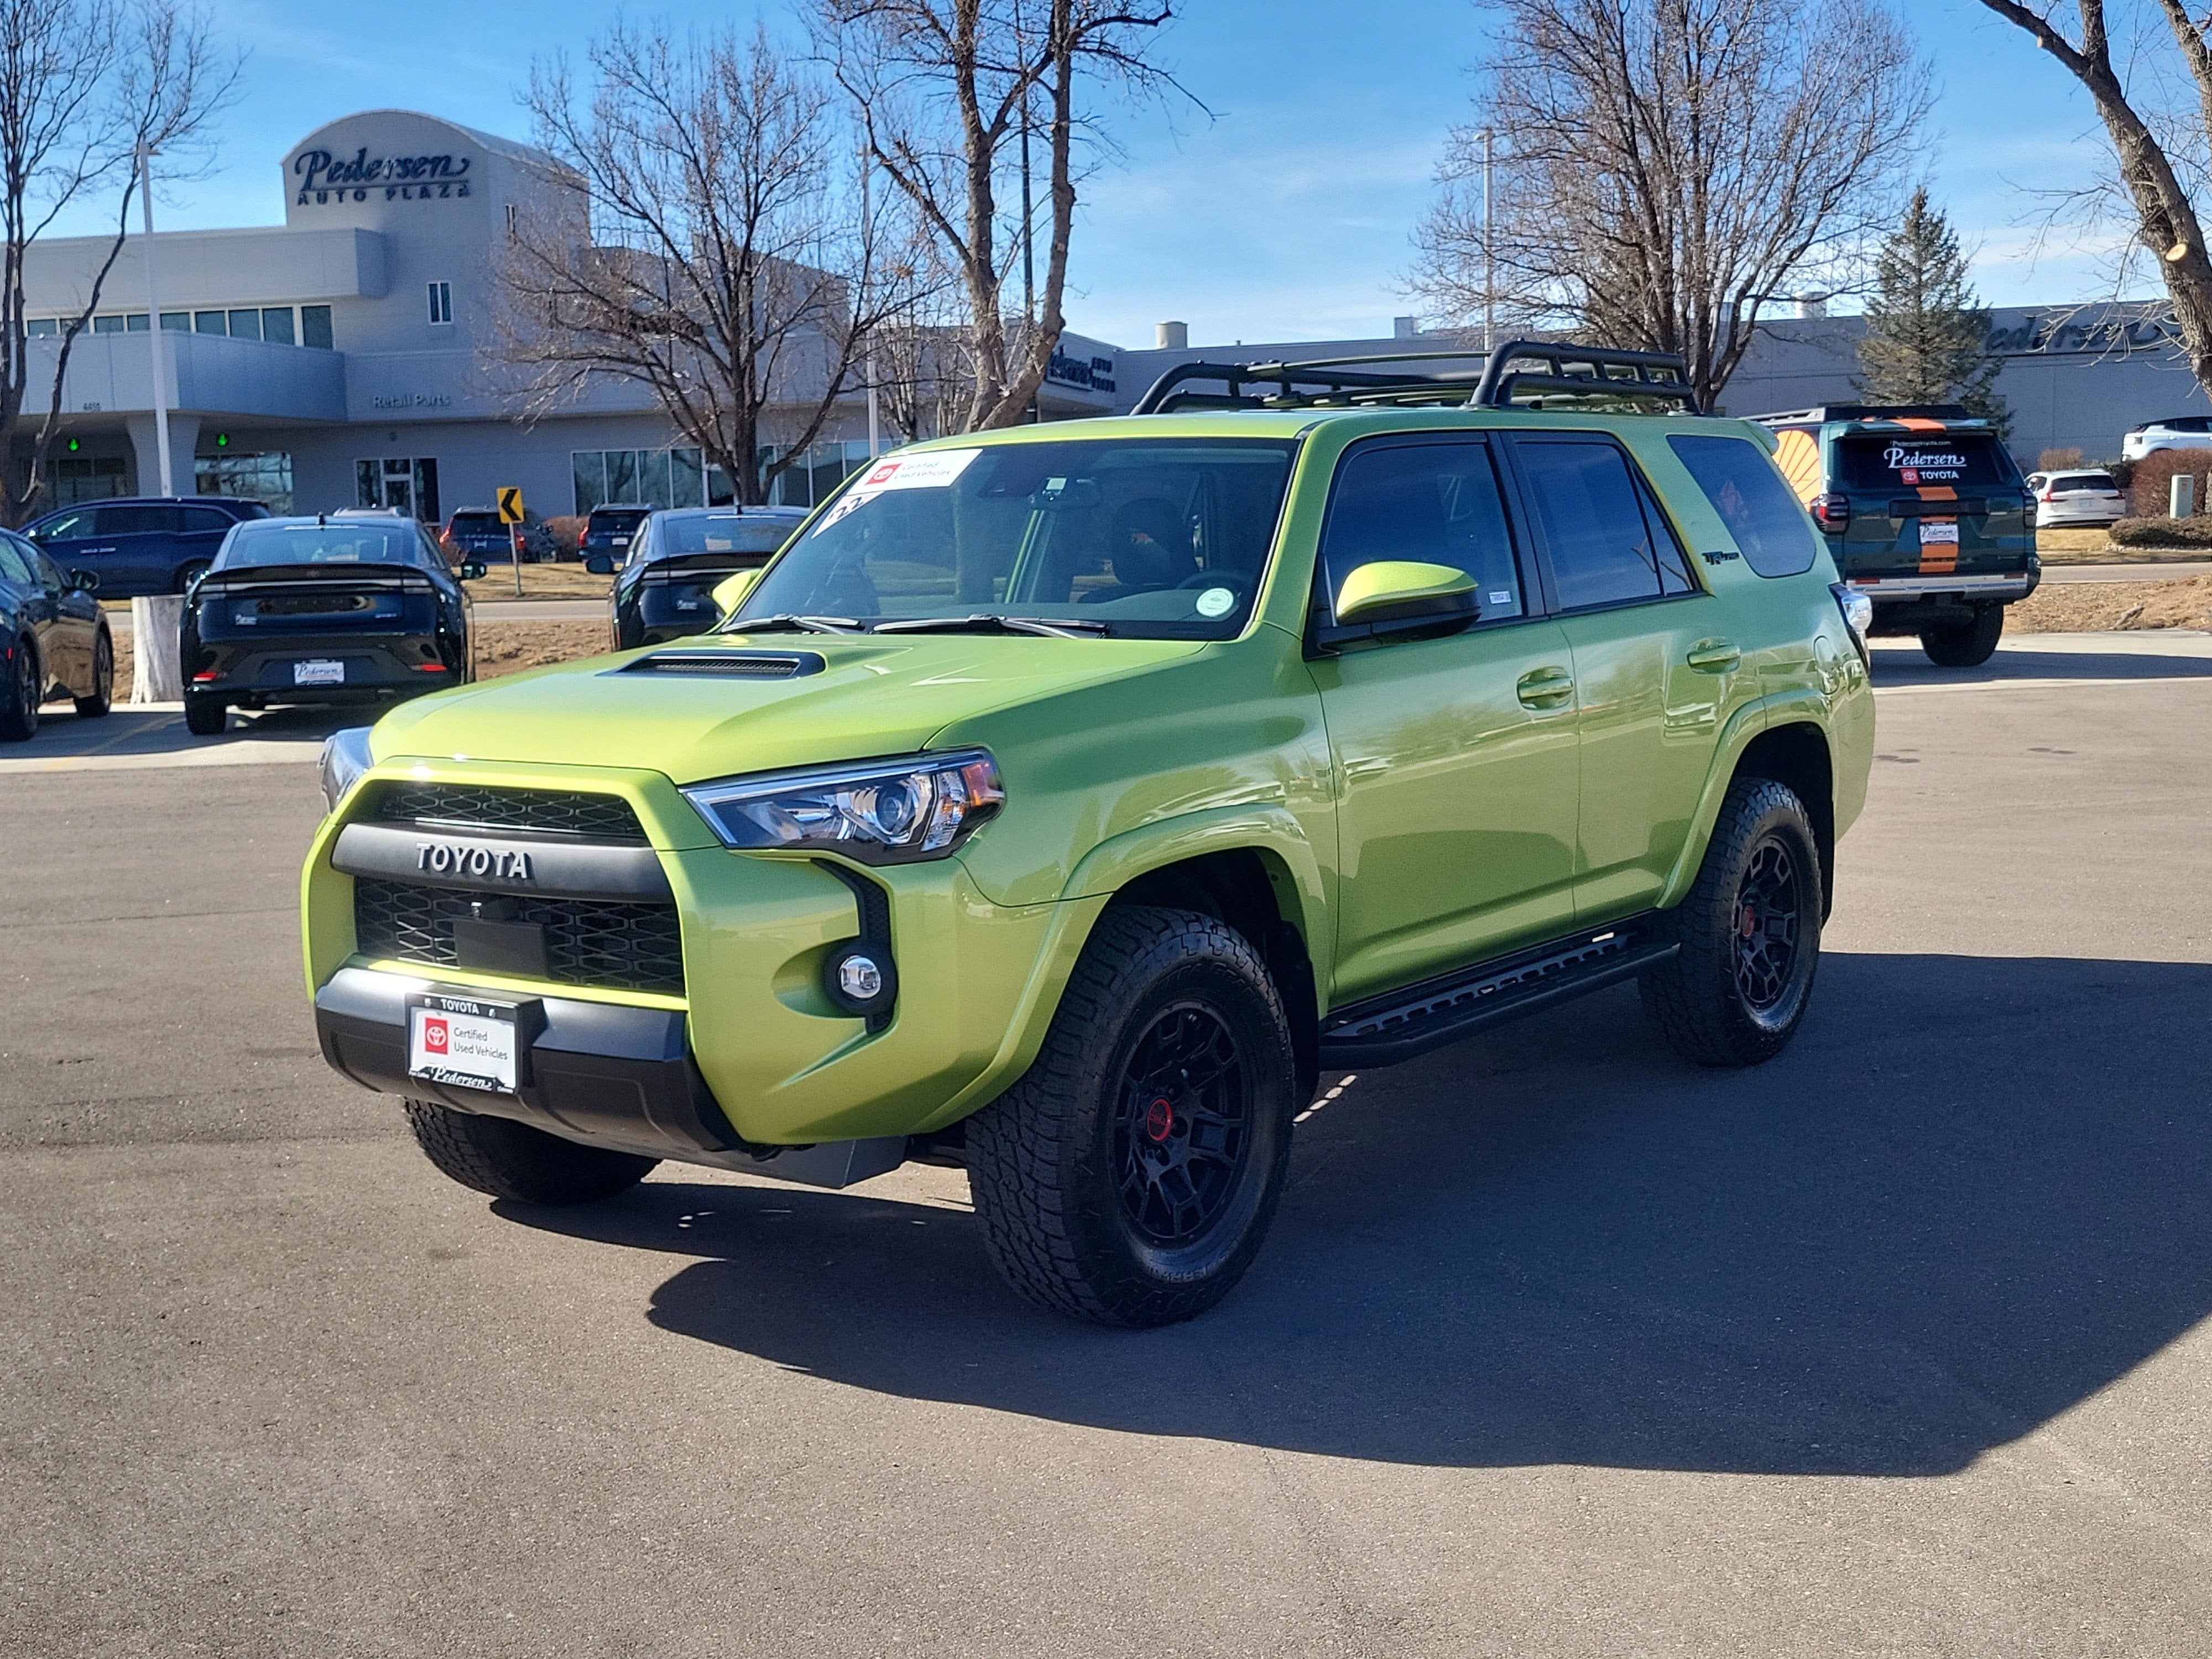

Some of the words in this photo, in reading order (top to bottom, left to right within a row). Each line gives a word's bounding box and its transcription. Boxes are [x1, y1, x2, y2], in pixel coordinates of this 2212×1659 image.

[294, 147, 470, 190] Pedersen
[298, 189, 367, 205] AUTO
[385, 183, 470, 201] PLAZA
[1884, 448, 1965, 468] Pedersen
[1919, 471, 1959, 479] TOYOTA
[416, 842, 527, 878] TOYOTA
[440, 999, 480, 1015] TOYOTA
[454, 1027, 488, 1042] Certified
[454, 1042, 473, 1054] Used
[476, 1044, 508, 1060] Vehicles
[431, 1066, 493, 1089] Pedersen
